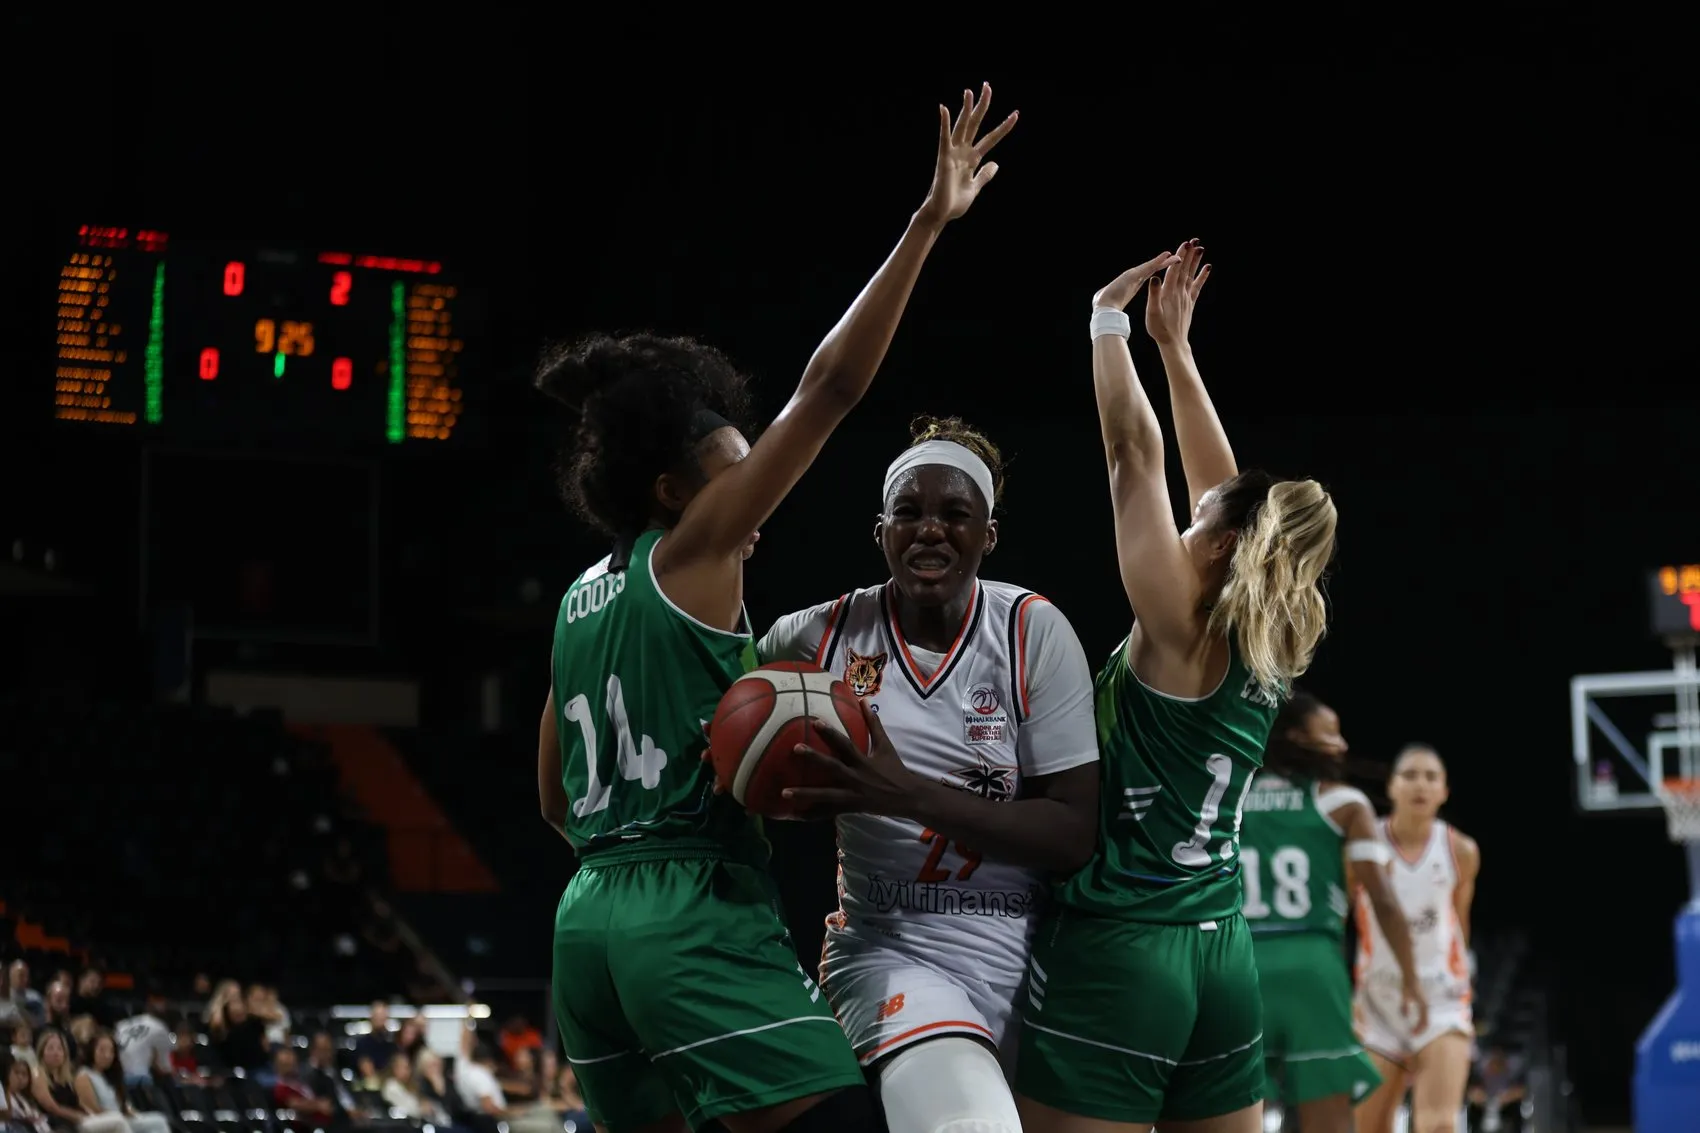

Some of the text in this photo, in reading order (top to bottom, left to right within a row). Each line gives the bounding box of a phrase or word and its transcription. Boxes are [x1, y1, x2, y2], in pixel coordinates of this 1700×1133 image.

[223, 261, 245, 296] 0
[329, 270, 352, 306] 2
[199, 347, 220, 380] 0
[331, 357, 353, 390] 0
[564, 673, 668, 818] 14
[1239, 846, 1312, 920] 18
